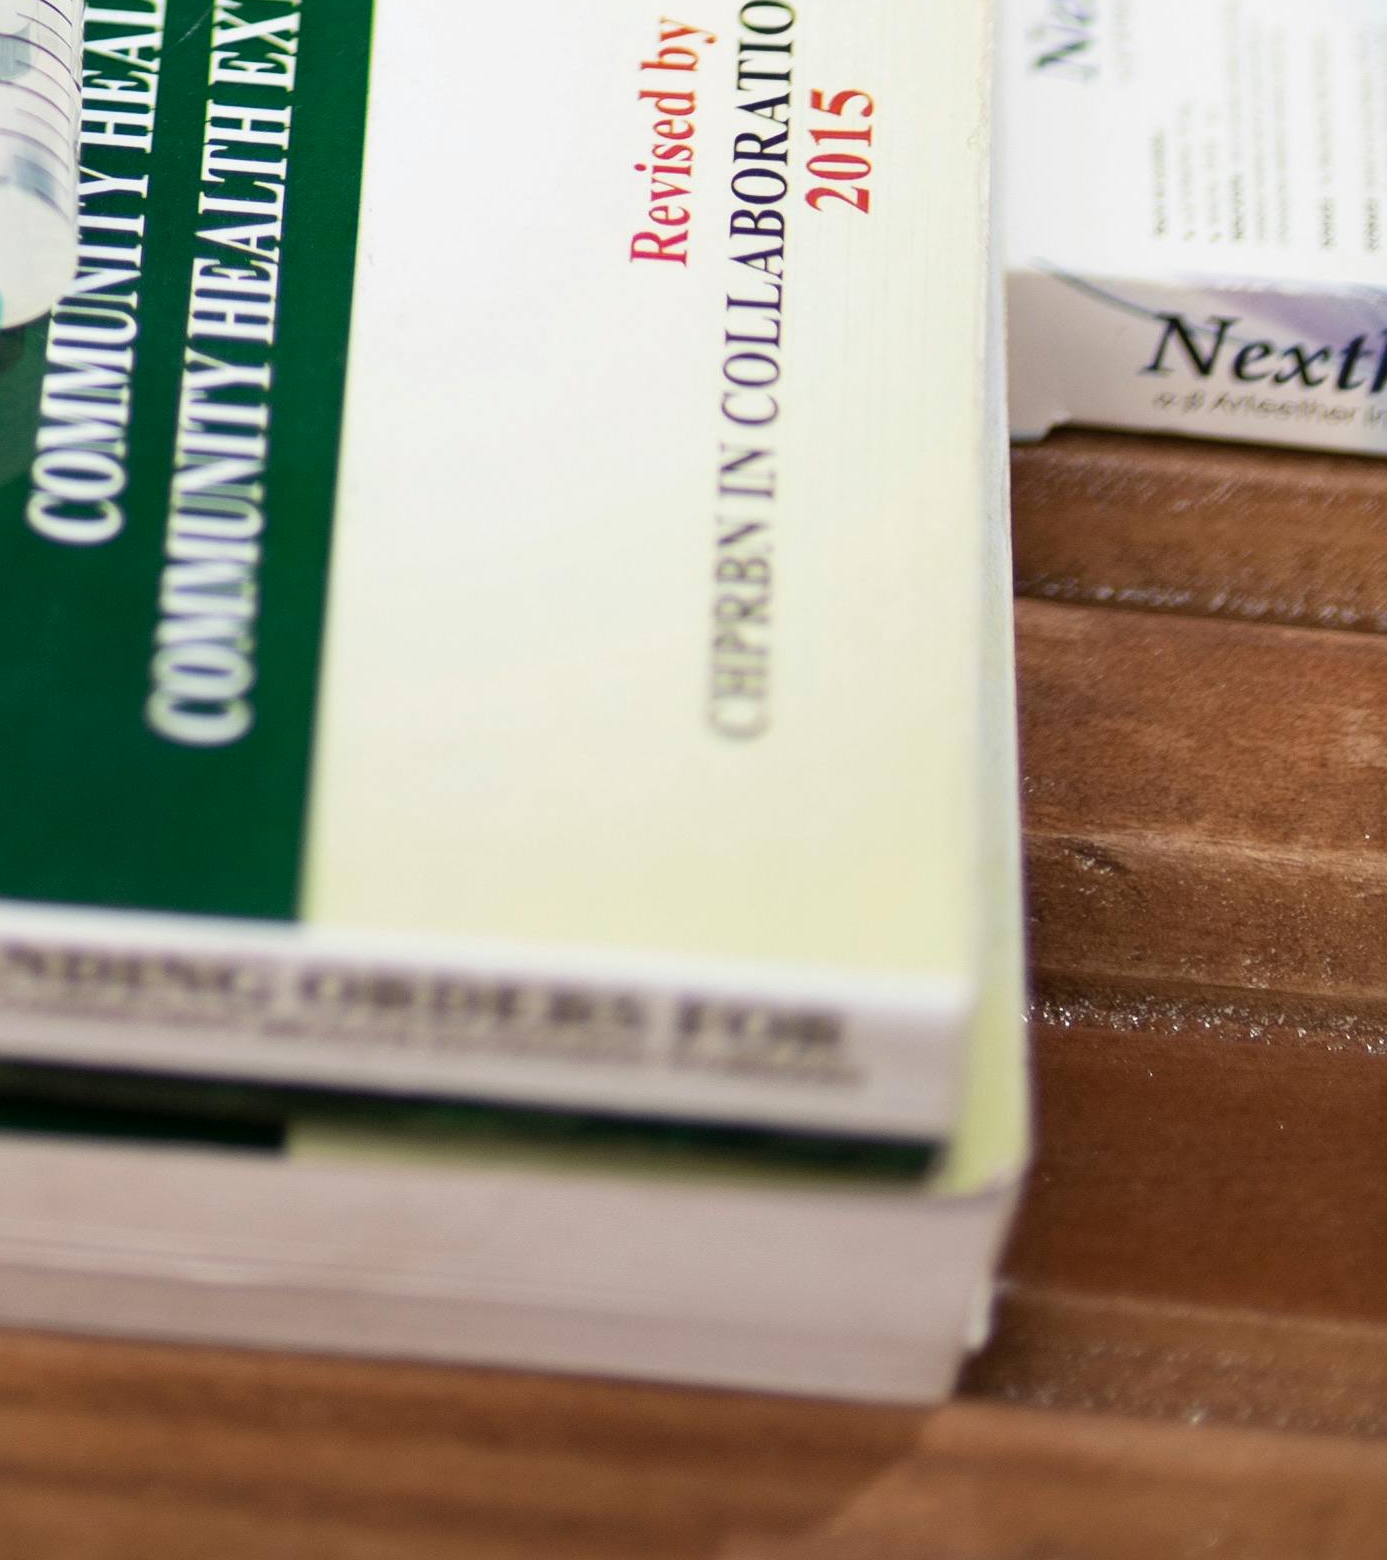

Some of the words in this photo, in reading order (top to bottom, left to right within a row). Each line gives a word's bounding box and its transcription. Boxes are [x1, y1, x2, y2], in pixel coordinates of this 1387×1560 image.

[639, 17, 717, 74] by
[186, 100, 292, 346] HEALTH
[629, 88, 697, 267] Revised
[804, 87, 875, 215] 2015
[27, 162, 150, 545] COMMUNITY
[146, 346, 272, 748] COMMUNITY
[718, 443, 776, 500] IN
[705, 517, 774, 741] CHPRBN
